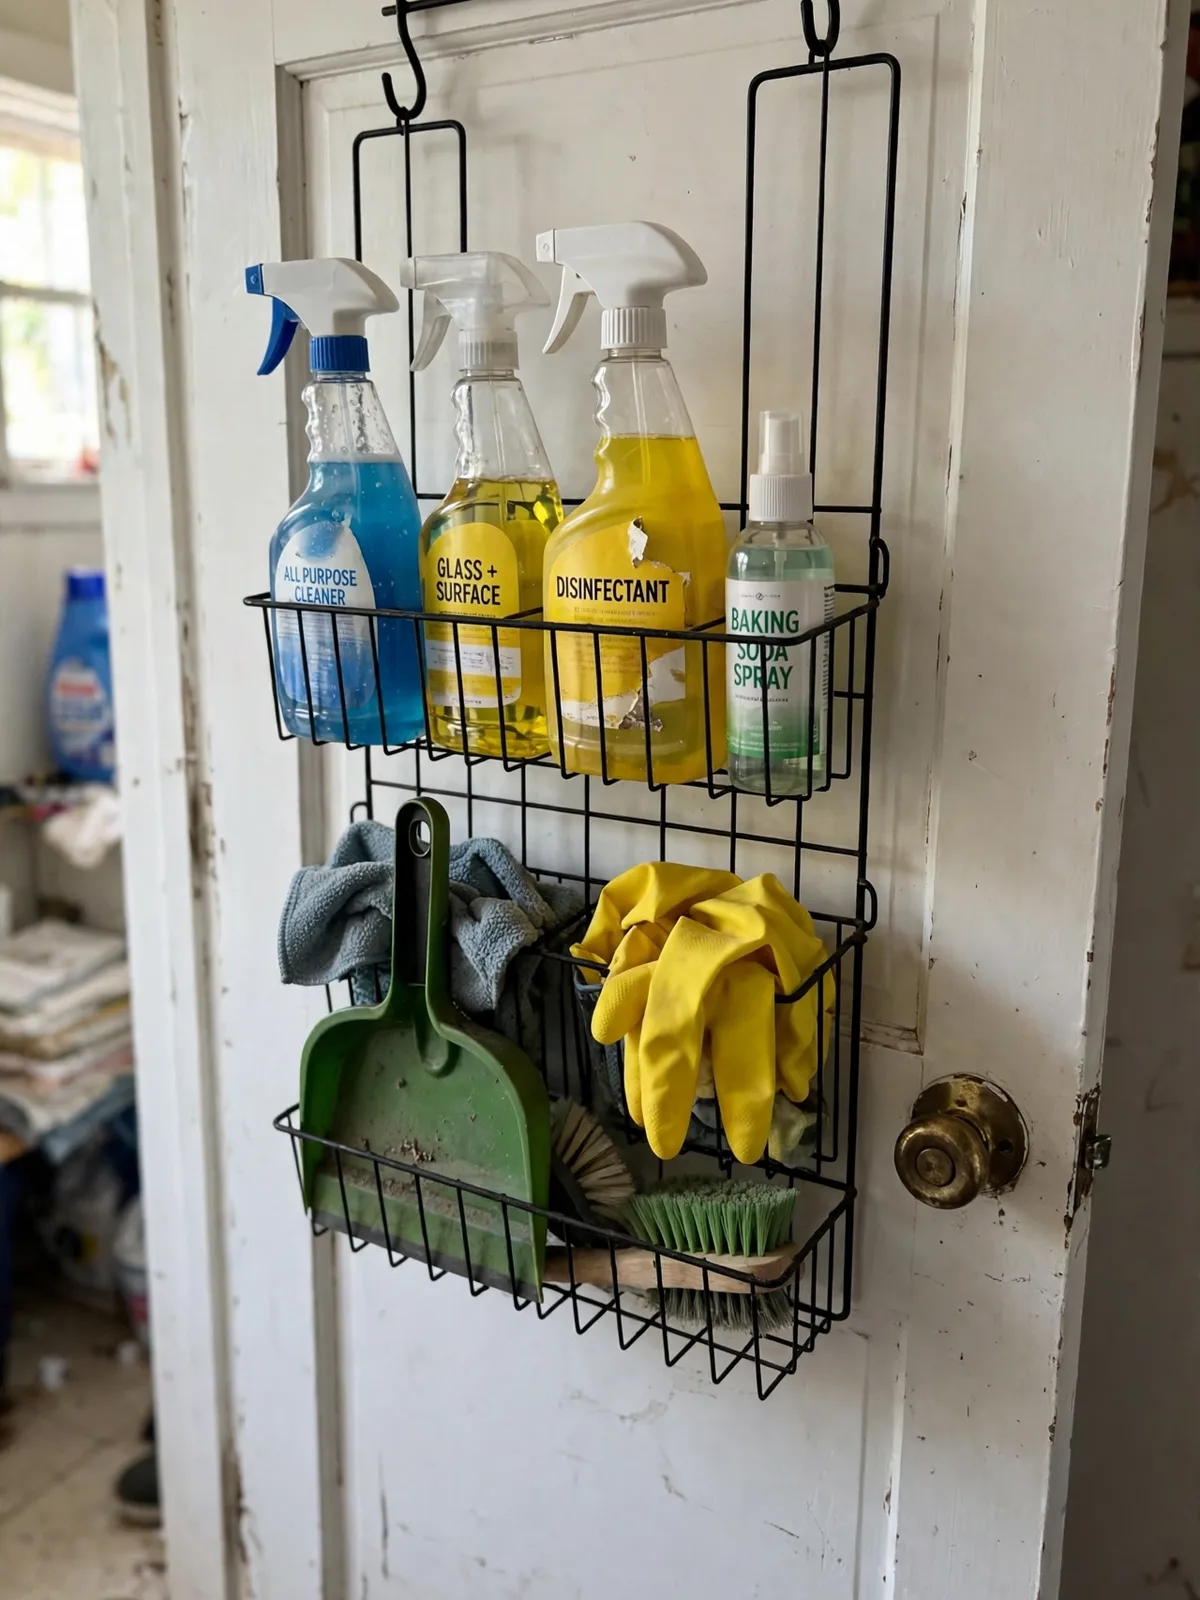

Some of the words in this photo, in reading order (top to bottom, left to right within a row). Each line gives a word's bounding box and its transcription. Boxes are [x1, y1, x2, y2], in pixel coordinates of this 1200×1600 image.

[284, 566, 301, 582] ALL
[303, 567, 357, 586] PURPOSE
[437, 557, 482, 581] GLASS
[487, 565, 497, 578] +
[295, 586, 346, 605] CLEANER
[436, 581, 500, 605] SURFACE
[556, 576, 669, 603] DISINFECTANT
[731, 607, 800, 633] BAKING
[737, 642, 788, 661] SODA
[734, 663, 793, 690] SPRAY
